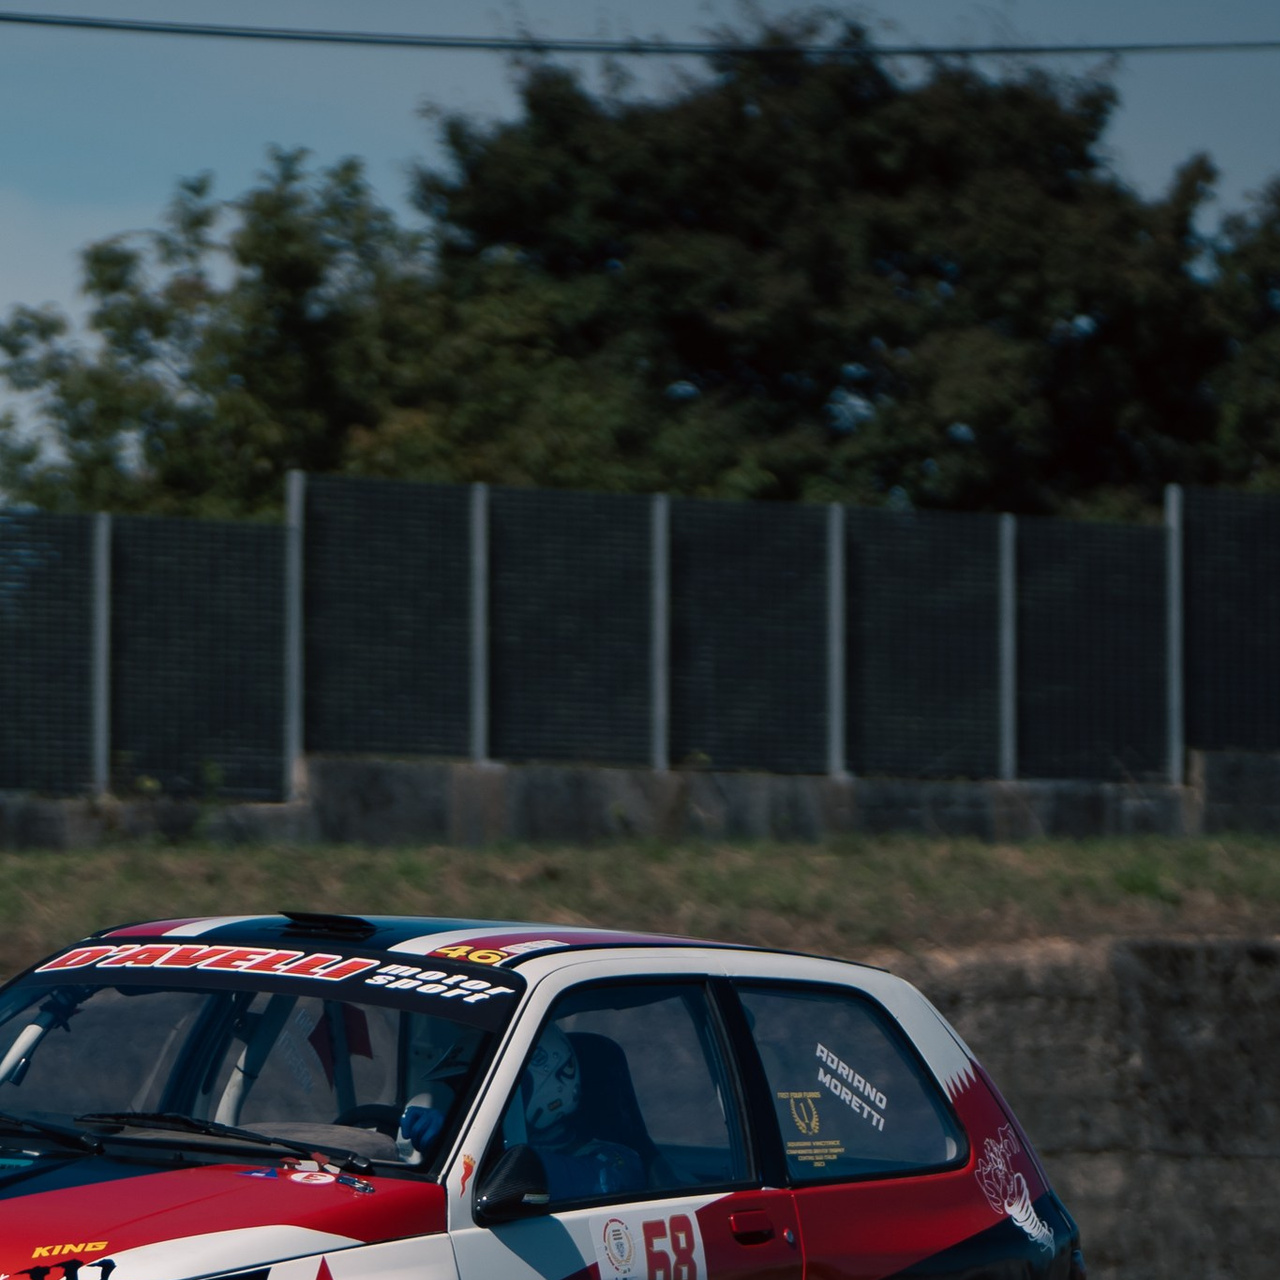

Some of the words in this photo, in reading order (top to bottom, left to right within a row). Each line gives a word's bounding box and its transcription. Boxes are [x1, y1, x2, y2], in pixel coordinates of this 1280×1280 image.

[34, 944, 381, 981] D'AVELLI
[435, 945, 508, 964] 46
[365, 975, 490, 1003] sport
[376, 964, 515, 995] motor
[816, 1042, 887, 1110] ADRIANO
[817, 1066, 885, 1132] MORETTI
[31, 1241, 109, 1259] KING
